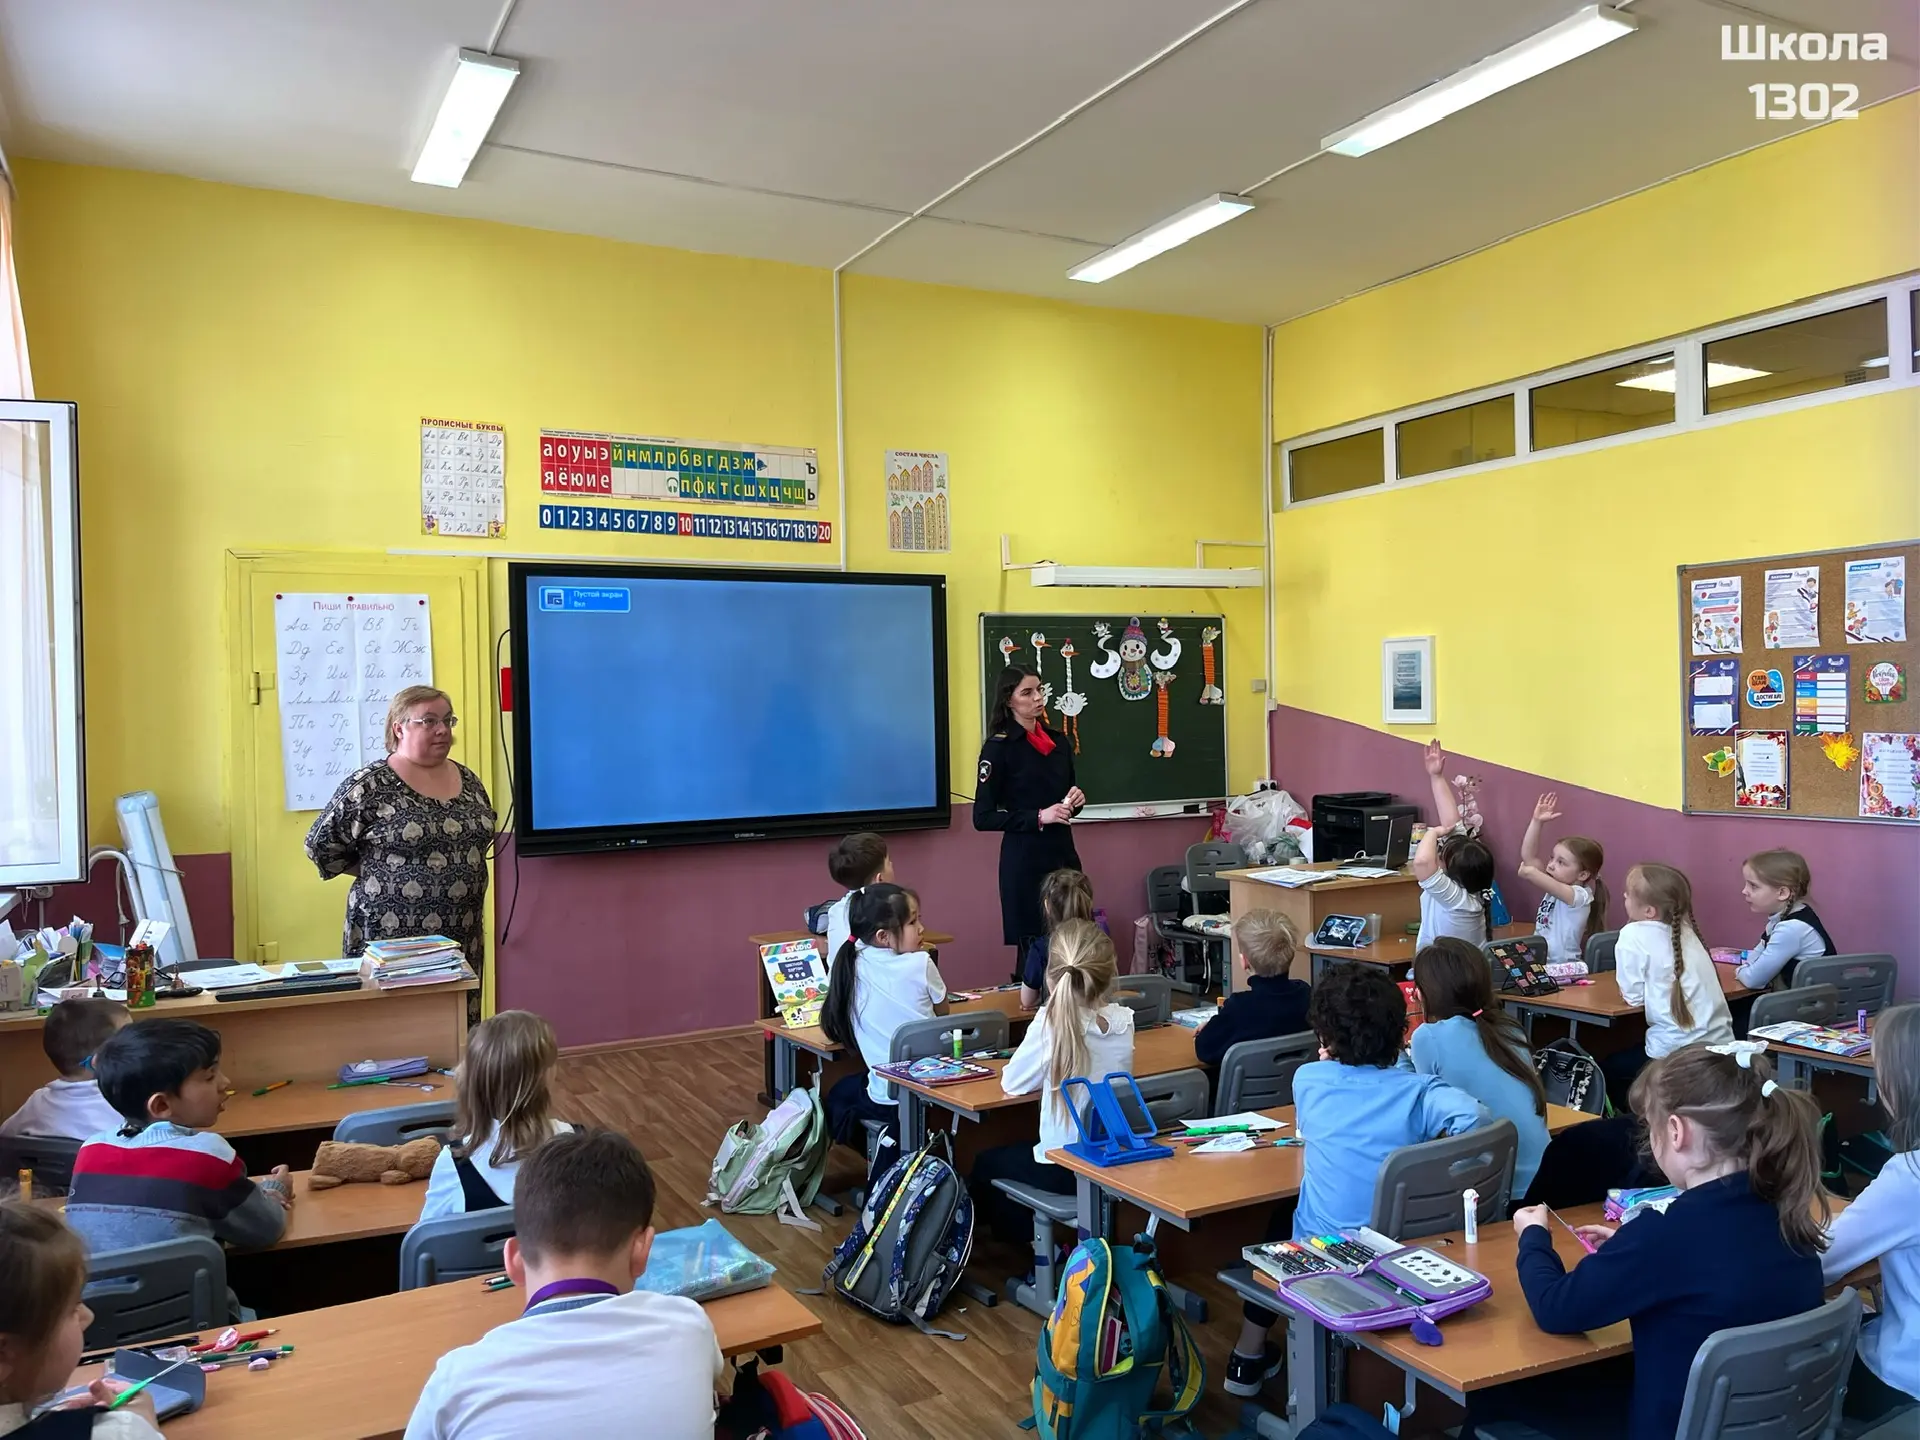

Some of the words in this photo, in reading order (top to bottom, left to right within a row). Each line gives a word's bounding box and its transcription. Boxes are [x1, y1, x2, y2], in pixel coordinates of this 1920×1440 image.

[421, 418, 474, 429] ПРОПИСНЫЕ
[476, 423, 504, 432] БУКВЫ
[543, 509, 551, 525] 0
[558, 510, 564, 525] 1
[571, 510, 579, 526] 2
[586, 511, 593, 527] 3
[600, 512, 608, 527] 4
[613, 513, 621, 528] 5
[627, 514, 635, 529] 6
[641, 515, 648, 530] 7
[654, 515, 662, 530] 8
[668, 516, 676, 531] 9
[680, 517, 691, 532] 10
[694, 518, 705, 533] 11
[709, 519, 720, 534] 12
[724, 520, 734, 535] 13
[738, 520, 749, 536] 14
[752, 521, 763, 536] 15
[766, 522, 777, 537] 16
[779, 523, 790, 538] 17
[793, 524, 804, 539] 18
[806, 525, 817, 539] 19
[819, 526, 830, 540] 20
[574, 590, 600, 598] Пустой
[574, 600, 586, 608] Вкл
[786, 943, 812, 953] STUDIO
